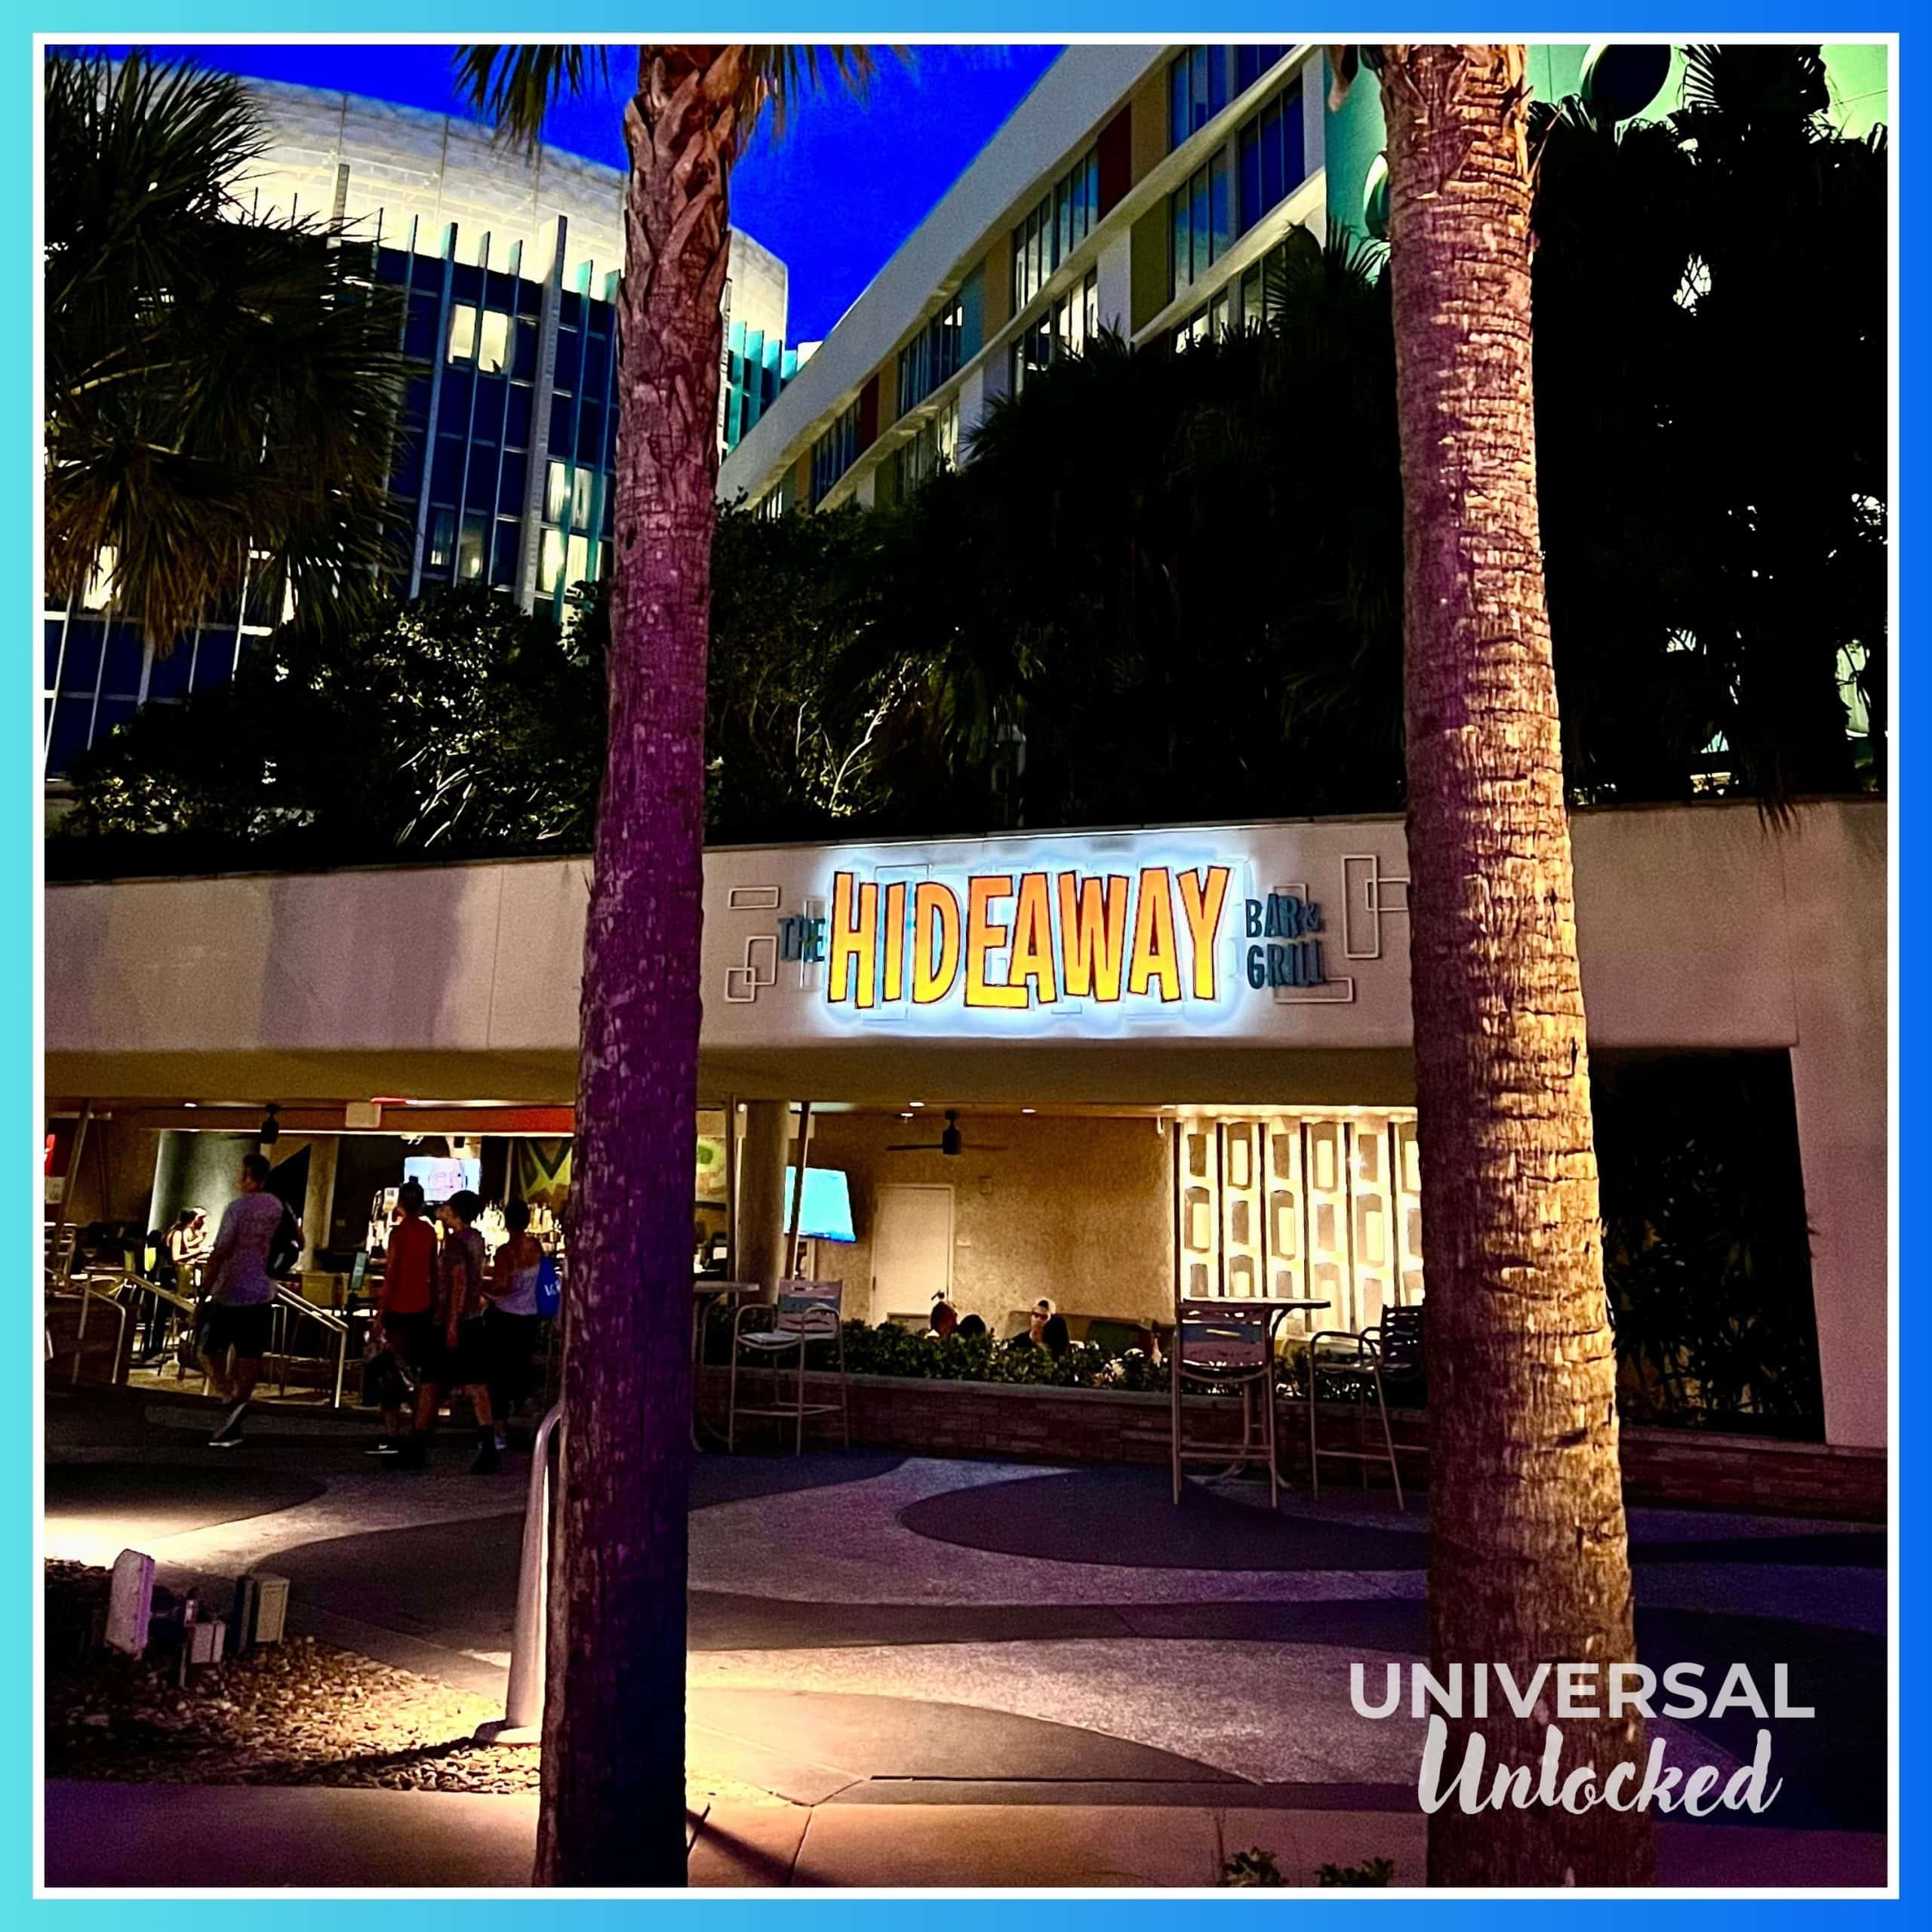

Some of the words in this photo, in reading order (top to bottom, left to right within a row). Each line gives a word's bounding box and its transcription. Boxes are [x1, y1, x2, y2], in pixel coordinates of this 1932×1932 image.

[777, 915, 825, 962] THE
[828, 866, 1232, 1009] HIDEAWAY
[1247, 941, 1324, 989] GRILL
